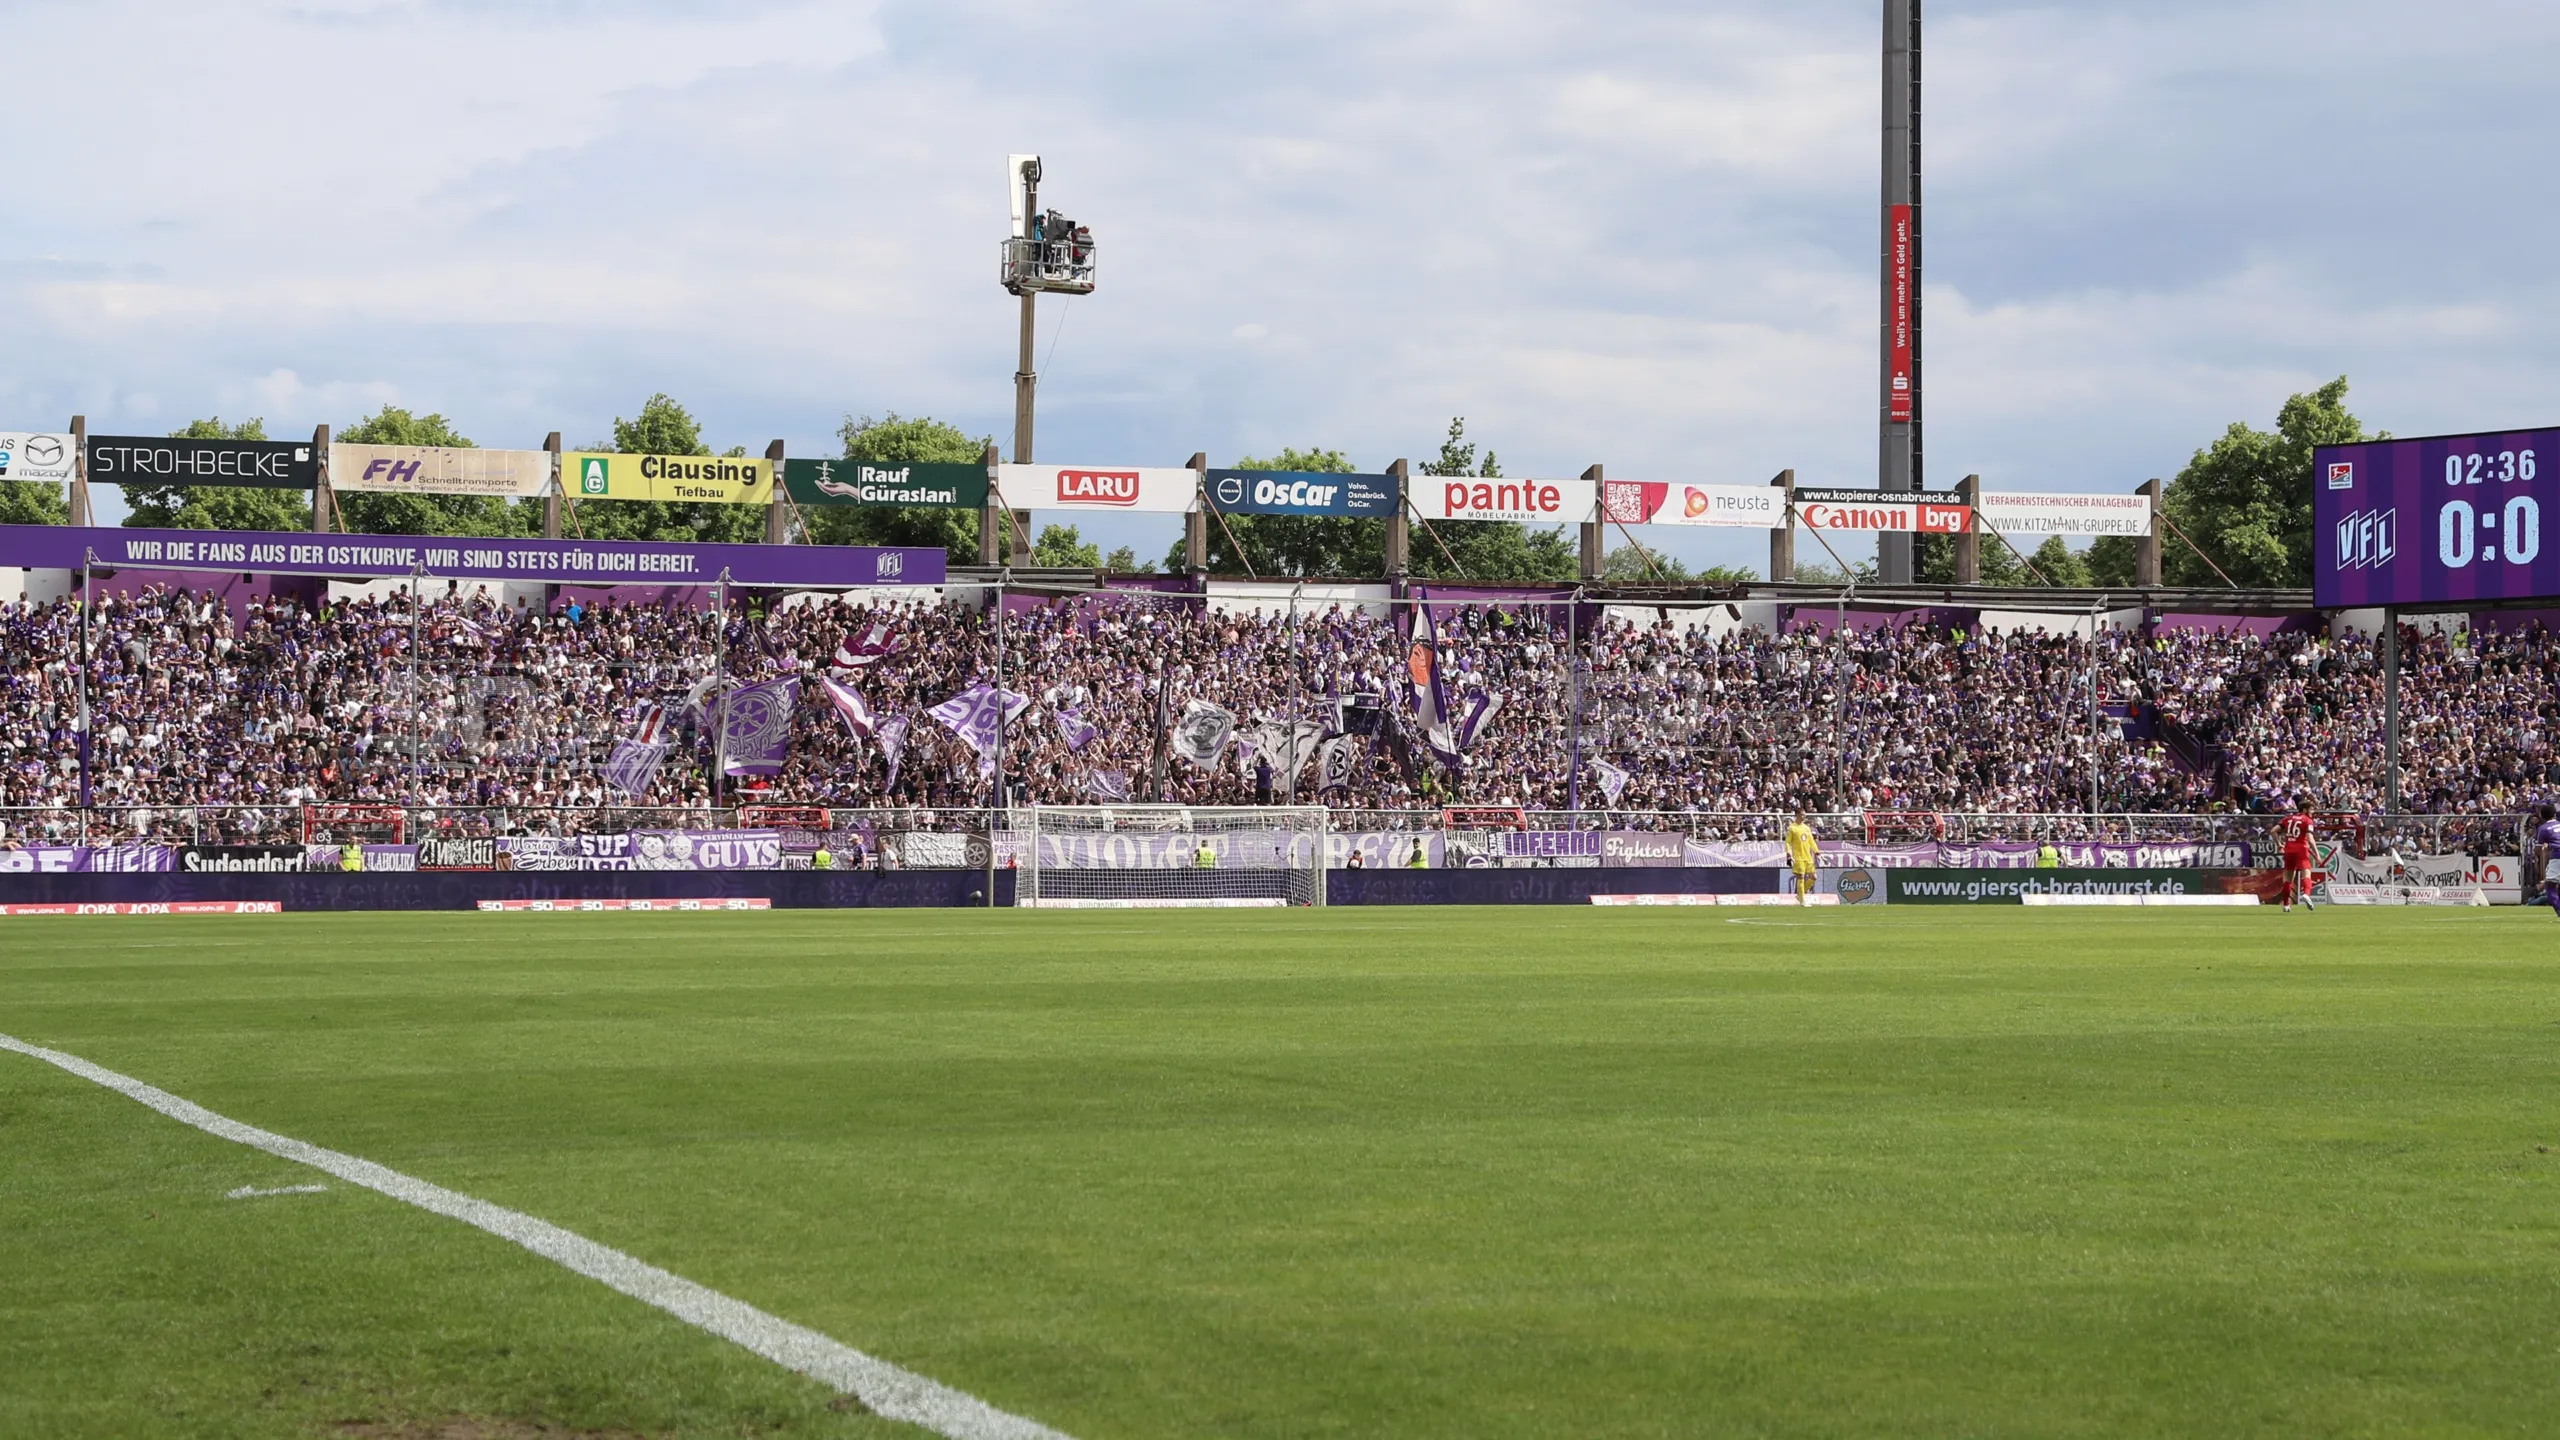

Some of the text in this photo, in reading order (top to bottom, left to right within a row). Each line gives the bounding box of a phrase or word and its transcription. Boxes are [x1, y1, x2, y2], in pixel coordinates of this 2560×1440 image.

[1897, 219, 1908, 348] Weil's um mehr als Geld geht.
[96, 447, 289, 477] STROHBECKE
[362, 459, 422, 482] FH
[640, 456, 757, 486] Clausing
[2446, 449, 2536, 486] 02:36
[418, 475, 518, 487] Schnelltransporte
[861, 466, 910, 483] Rauf
[674, 486, 724, 499] Tiefbau
[861, 485, 952, 503] Güraslan
[1062, 475, 1134, 498] LARU
[1254, 479, 1338, 507] OsCar
[1348, 482, 1370, 491] Volvo.
[1348, 490, 1387, 500] Osnabrück.
[1348, 500, 1372, 509] OsCar.
[1445, 480, 1561, 518] pante
[1716, 495, 1770, 511] neusta
[1804, 489, 1961, 504] www.kopierer-osnabrueck.de
[1985, 495, 2144, 508] VERFAHRENSTECHNISCHER ANLAGENBAU
[1467, 511, 1538, 520] MÖBELFABRIK
[1804, 504, 1962, 532] Canon brg
[1990, 515, 2139, 533] WWW.KITZMANN-GRUPPE.DE
[2439, 495, 2540, 569] 0:0
[126, 541, 162, 561] WIR
[166, 541, 195, 562] DIE
[198, 543, 246, 563] FANS
[250, 544, 286, 564] AUS
[290, 545, 322, 565] DER
[425, 548, 459, 569] WIR
[463, 550, 502, 570] SIND
[507, 550, 559, 571] STETS
[563, 548, 594, 571] FÜR
[598, 553, 635, 572] DICH
[640, 554, 700, 574] BEREIT.
[2286, 819, 2302, 839] 16
[1504, 832, 1601, 857] INFERNO
[1606, 837, 1682, 863] Fighters
[513, 851, 579, 871] Erben
[699, 840, 780, 869] GUYS
[2136, 845, 2243, 868] PANTHER
[1902, 877, 2185, 901] www.giersch-bratwurst.de
[2333, 888, 2375, 898] ASSMANN
[2383, 889, 2431, 898] ASSANN
[2440, 889, 2475, 898] ASSMANN
[75, 903, 117, 914] JOPA
[128, 903, 170, 914] JOPA
[234, 901, 276, 913] JOPA
